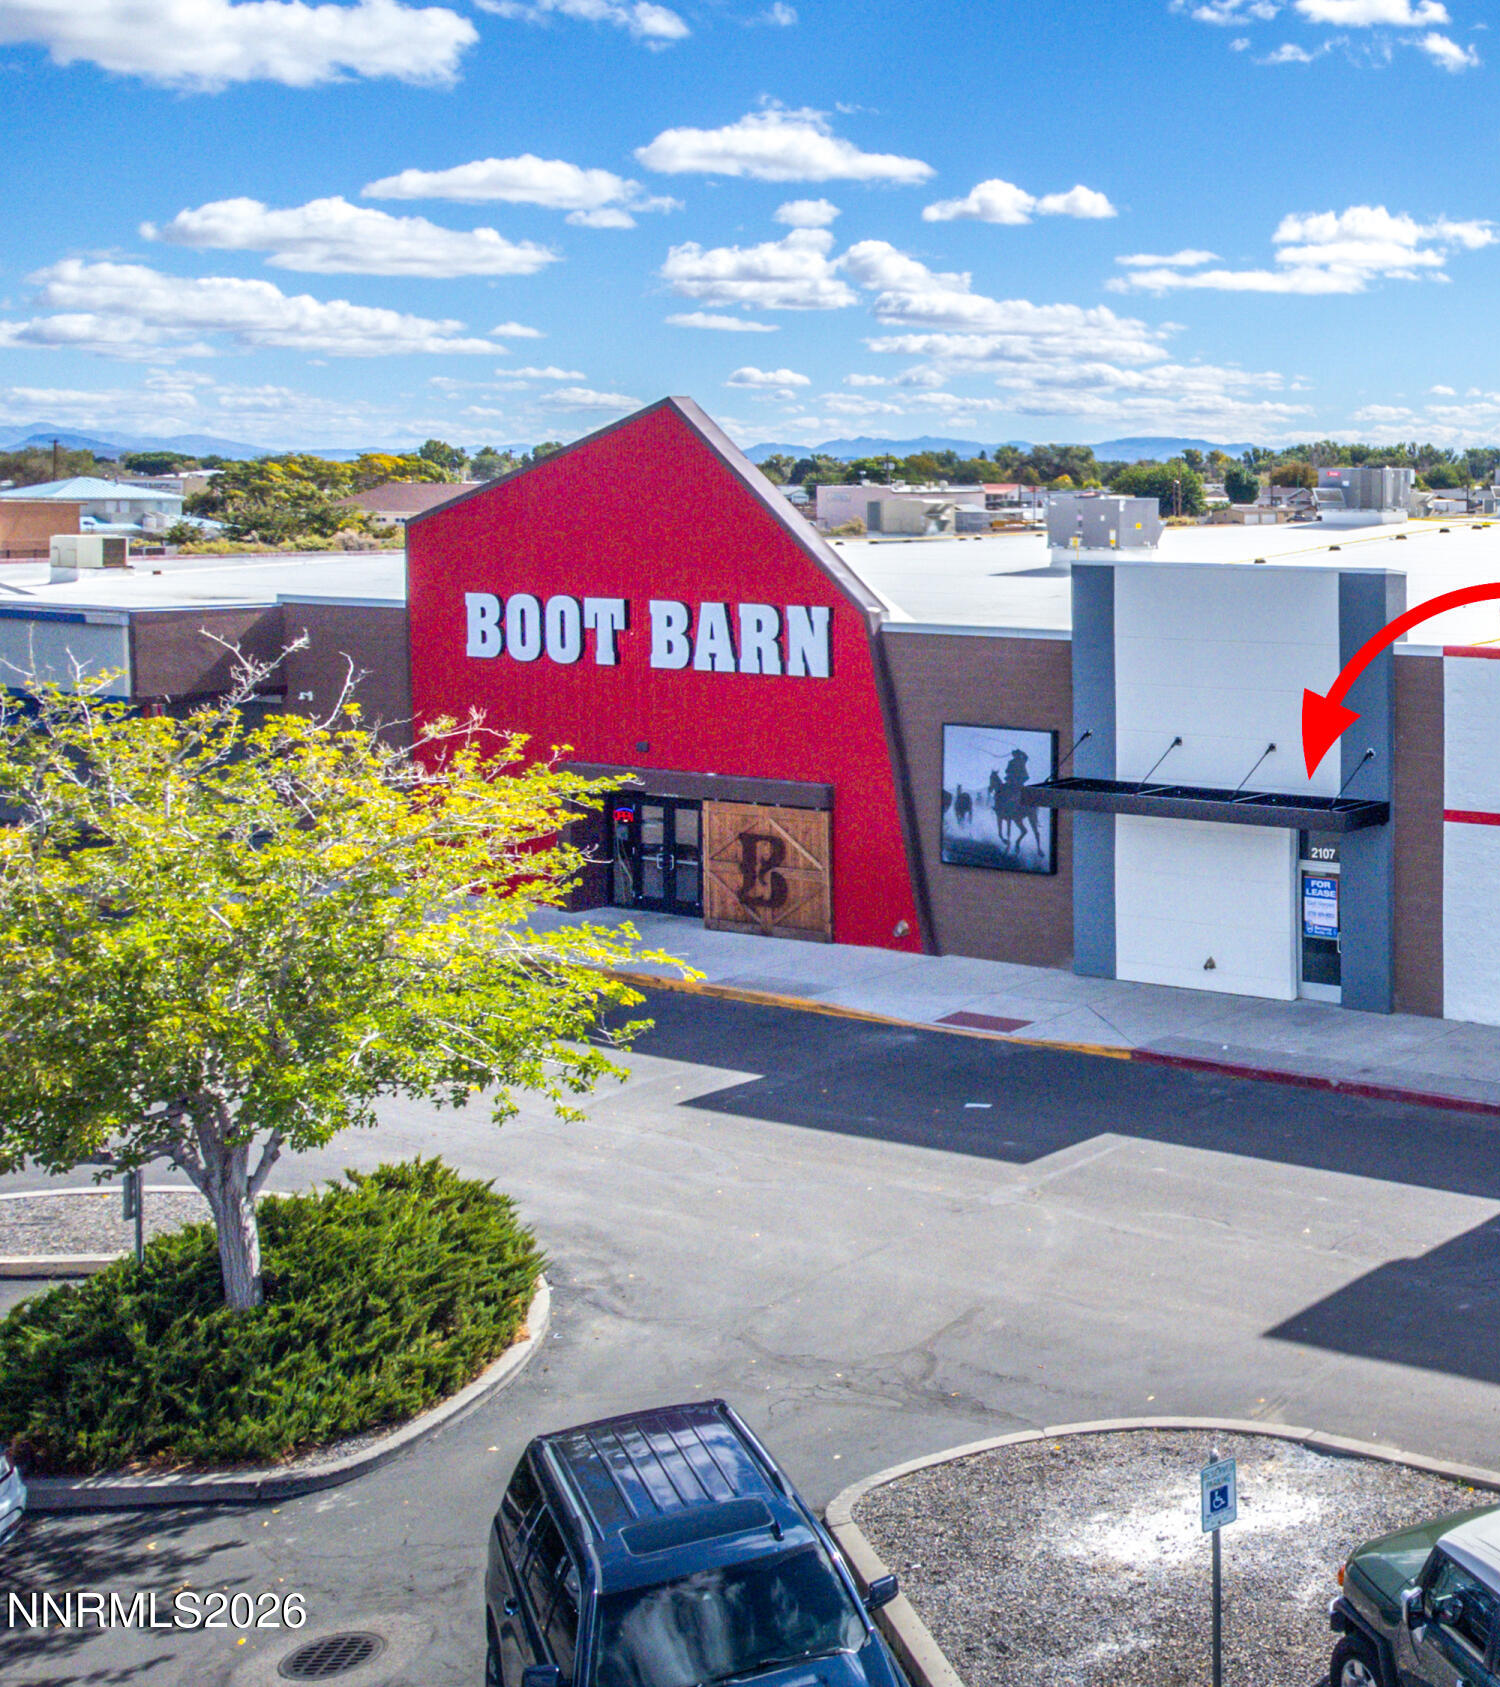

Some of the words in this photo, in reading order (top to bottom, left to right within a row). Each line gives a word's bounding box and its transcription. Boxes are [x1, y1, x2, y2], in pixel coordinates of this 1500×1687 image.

[465, 592, 626, 666] BOOT
[649, 600, 830, 678] BARN
[1311, 847, 1336, 860] 2107
[735, 832, 788, 909] B
[1311, 880, 1331, 889] FOR
[1305, 888, 1337, 898] LEASE
